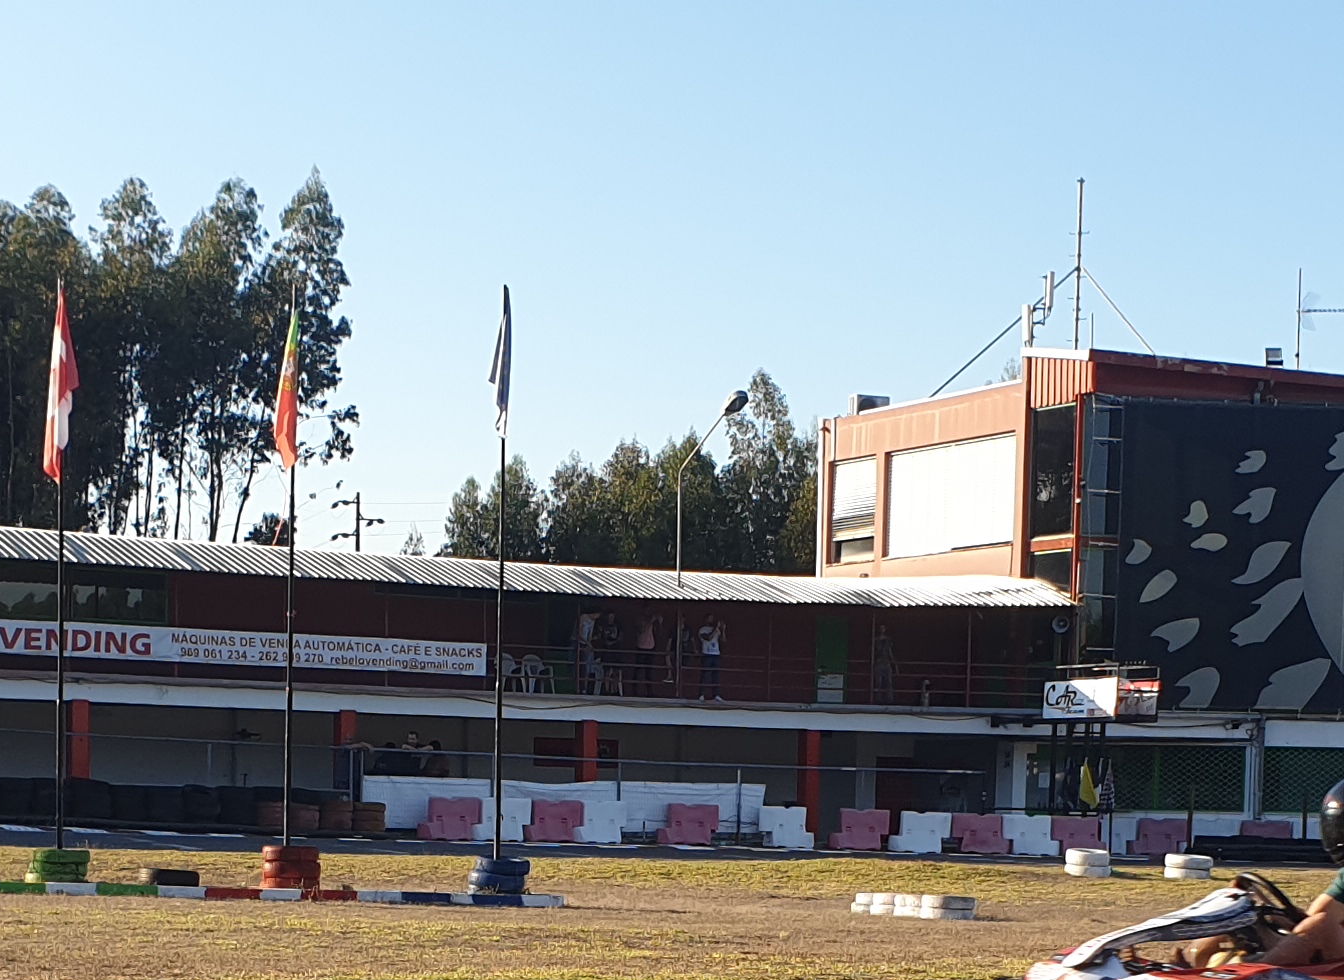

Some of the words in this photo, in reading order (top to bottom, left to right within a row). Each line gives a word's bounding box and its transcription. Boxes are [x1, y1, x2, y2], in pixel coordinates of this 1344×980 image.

[171, 630, 236, 647] MÁQUINAS
[239, 636, 257, 648] DE
[303, 639, 383, 654] AUTOMÁTICA
[391, 643, 422, 656] CAFÉ
[424, 645, 433, 656] E
[435, 646, 483, 659] SNACKS
[203, 648, 223, 660] 061
[227, 650, 248, 661] 234
[258, 651, 279, 662] 262
[282, 651, 301, 663] 99
[304, 652, 324, 664] 270
[330, 653, 475, 671] rebelovending@gmail.com
